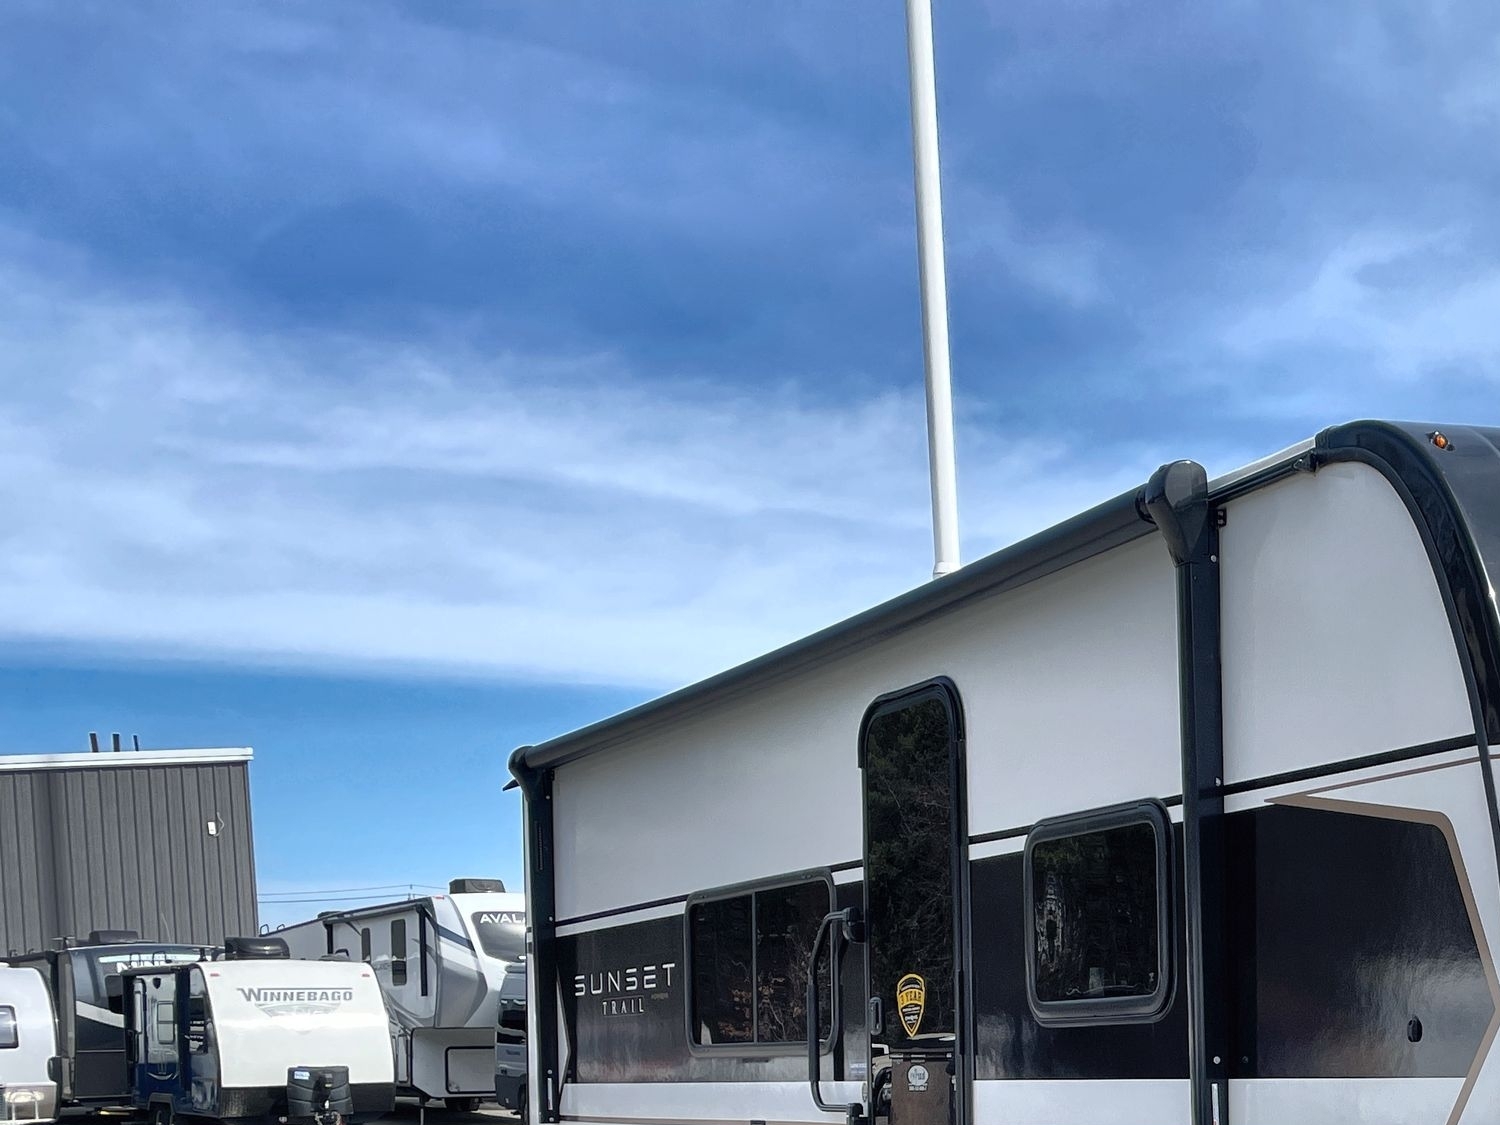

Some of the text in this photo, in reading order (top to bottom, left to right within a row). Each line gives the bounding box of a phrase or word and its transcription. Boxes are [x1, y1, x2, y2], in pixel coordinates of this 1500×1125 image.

[479, 913, 525, 924] AVAL
[574, 963, 675, 997] SUNSET
[236, 987, 353, 1002] WINNEBAGO
[602, 998, 644, 1016] TRAIL
